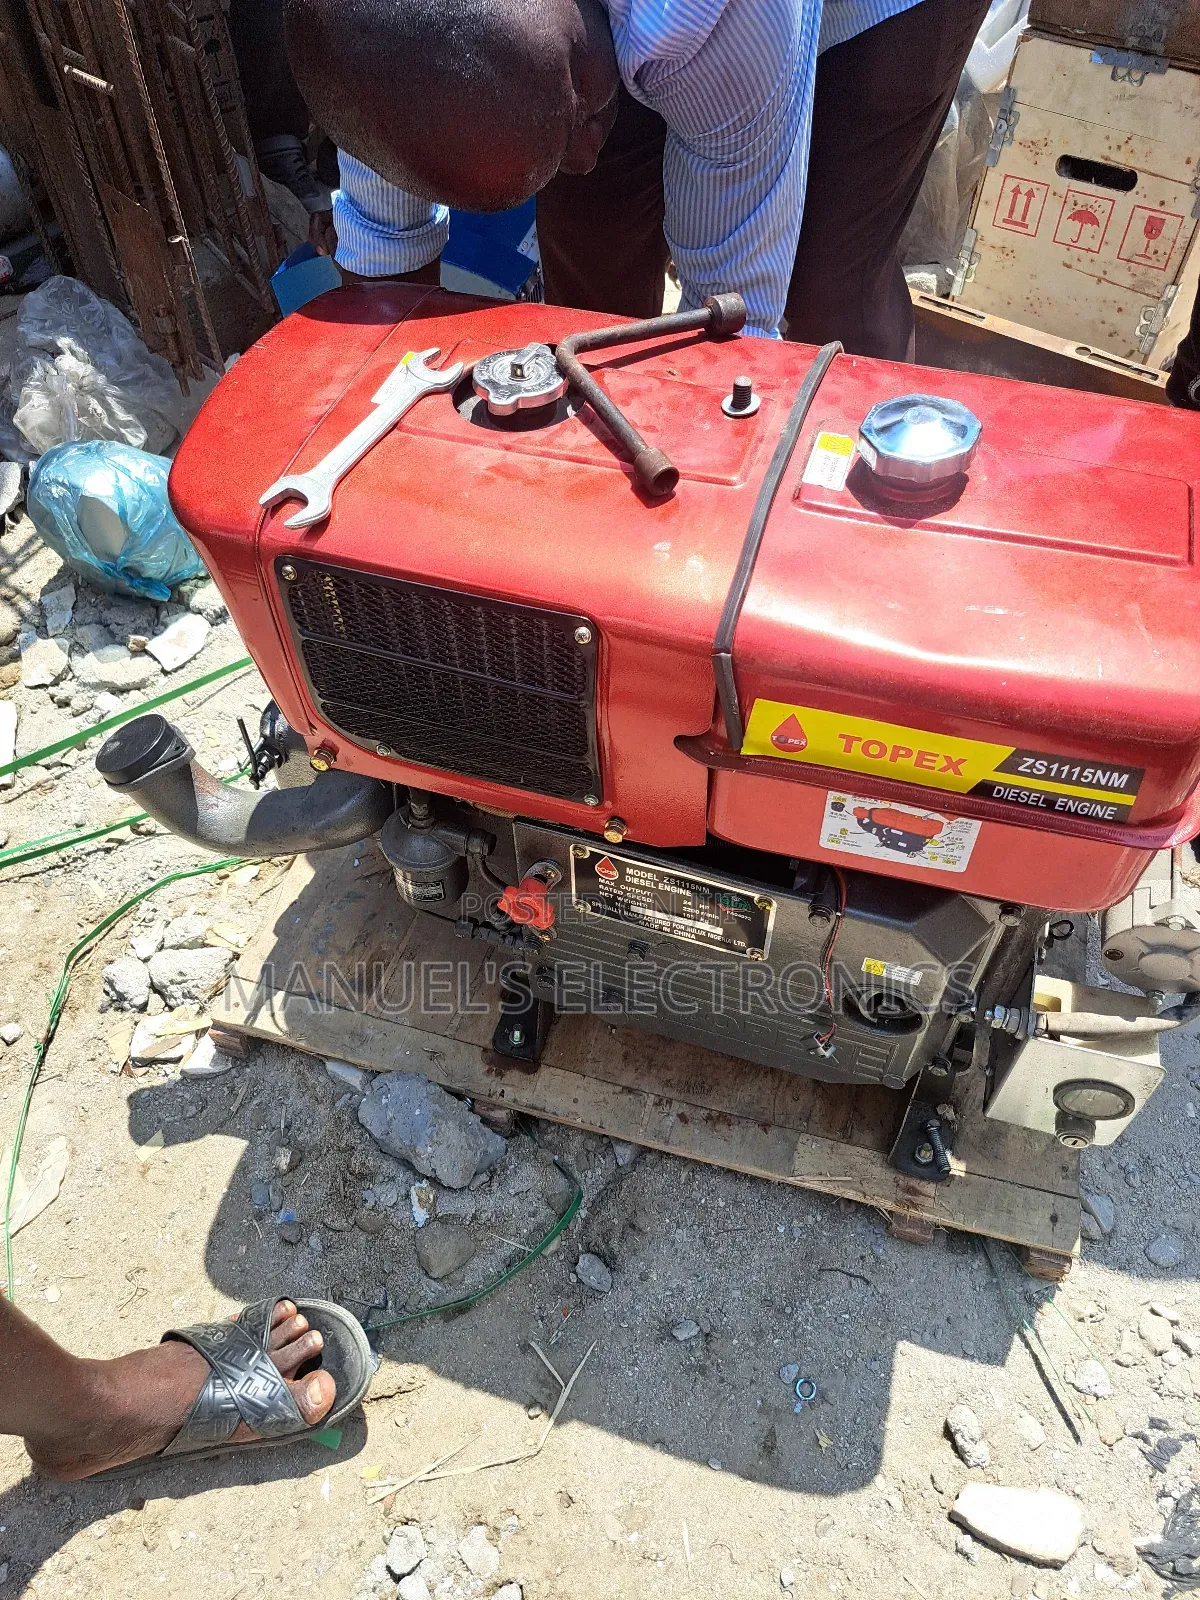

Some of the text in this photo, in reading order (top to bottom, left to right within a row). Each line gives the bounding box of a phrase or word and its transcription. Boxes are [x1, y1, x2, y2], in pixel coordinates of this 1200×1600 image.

[771, 734, 807, 747] TOPEX
[837, 732, 968, 777] TOPEX
[1016, 755, 1130, 789] ZS1115NM
[991, 784, 1119, 820] DIESEL ENGINE
[625, 867, 660, 882] MODEL
[598, 890, 614, 899] NET
[624, 875, 692, 897] DIESEL ENGINE
[591, 900, 622, 914] SPECIALLY
[672, 921, 685, 931] FOR
[733, 939, 747, 948] LTD.
[638, 920, 660, 930] MADE
[673, 929, 696, 940] CHINA
